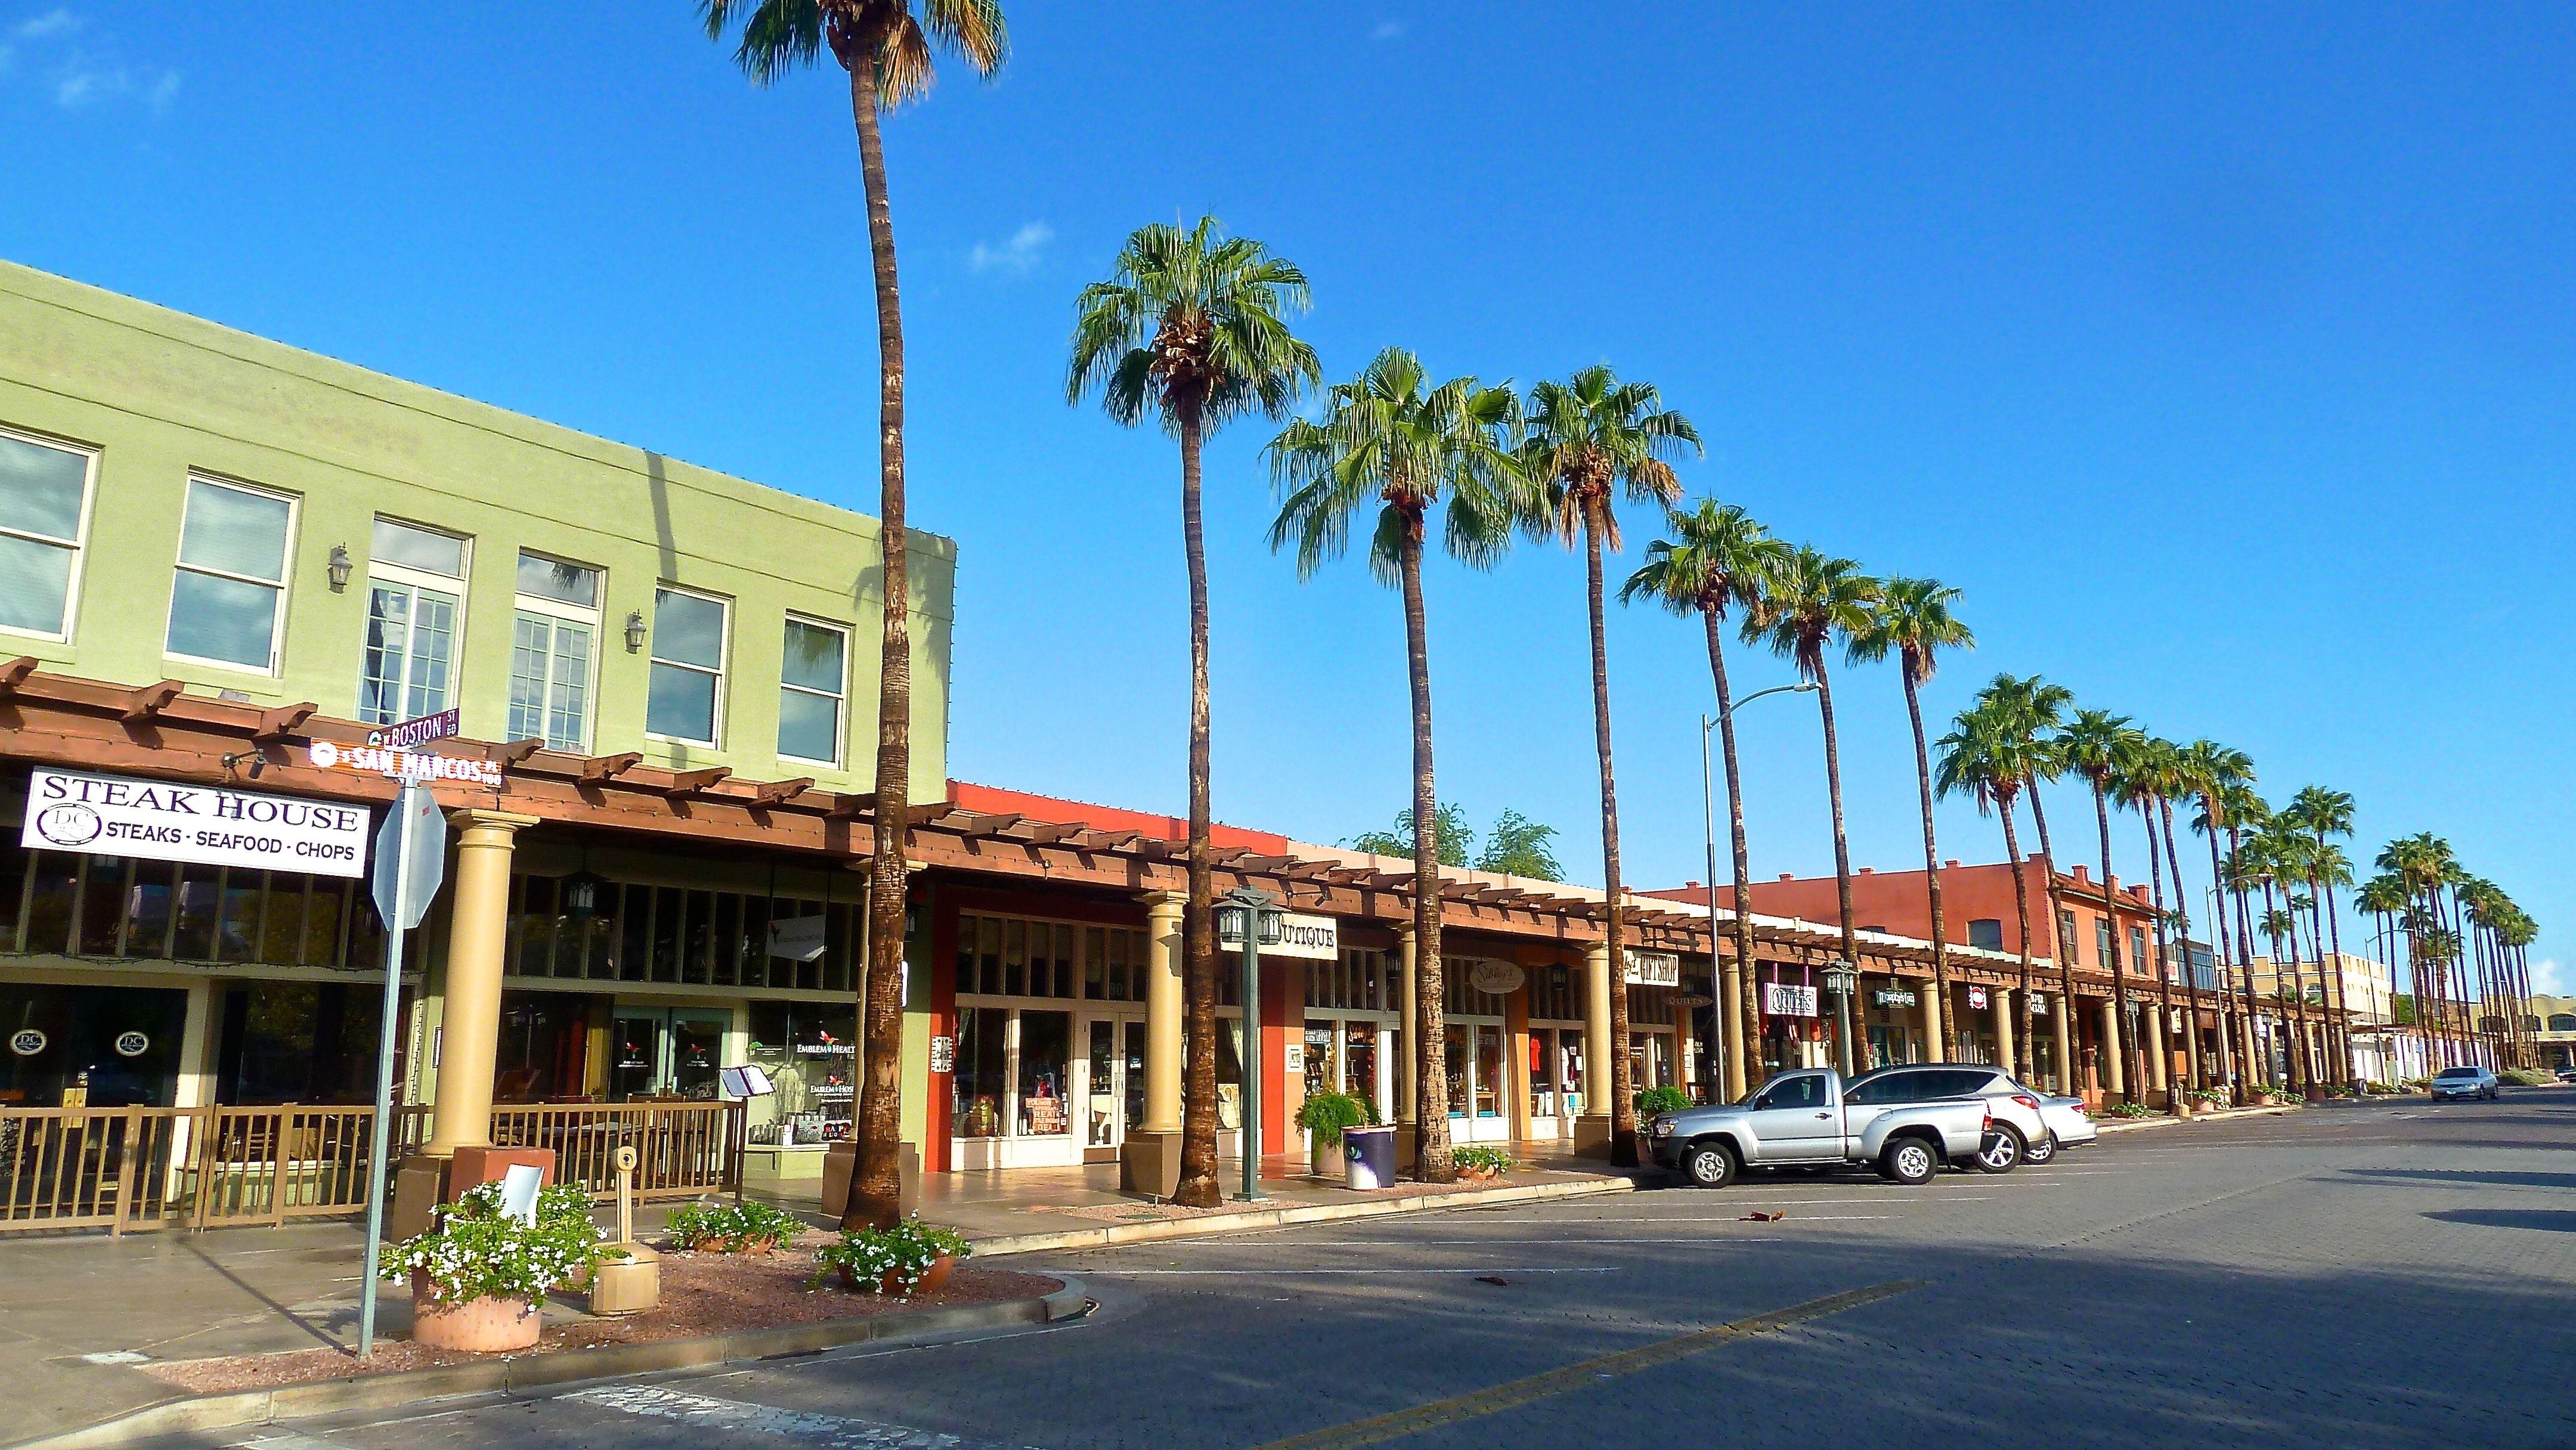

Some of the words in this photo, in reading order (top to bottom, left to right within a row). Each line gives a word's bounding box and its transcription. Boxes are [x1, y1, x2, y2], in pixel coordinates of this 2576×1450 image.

[391, 715, 443, 746] BOSTON
[447, 709, 456, 722] ST
[352, 746, 395, 772] SAN
[401, 752, 482, 783] MARCOS
[43, 776, 200, 814] STEAK
[213, 795, 358, 832] HOUSE
[53, 810, 88, 826] DC
[106, 822, 182, 844] STEAKS
[196, 831, 282, 853] SEAFOOD
[296, 841, 355, 860] CHOPS
[1281, 924, 1334, 949] UTIQUE
[1640, 955, 1657, 981] GIFT
[1658, 956, 1677, 982] SHOP
[1668, 996, 1703, 1006] QUILTS
[1772, 988, 1812, 1012] QUILTS
[20, 1034, 39, 1044] DC
[125, 1036, 142, 1045] DC
[797, 1044, 827, 1054] EMBLEM
[832, 1045, 856, 1054] HEALT
